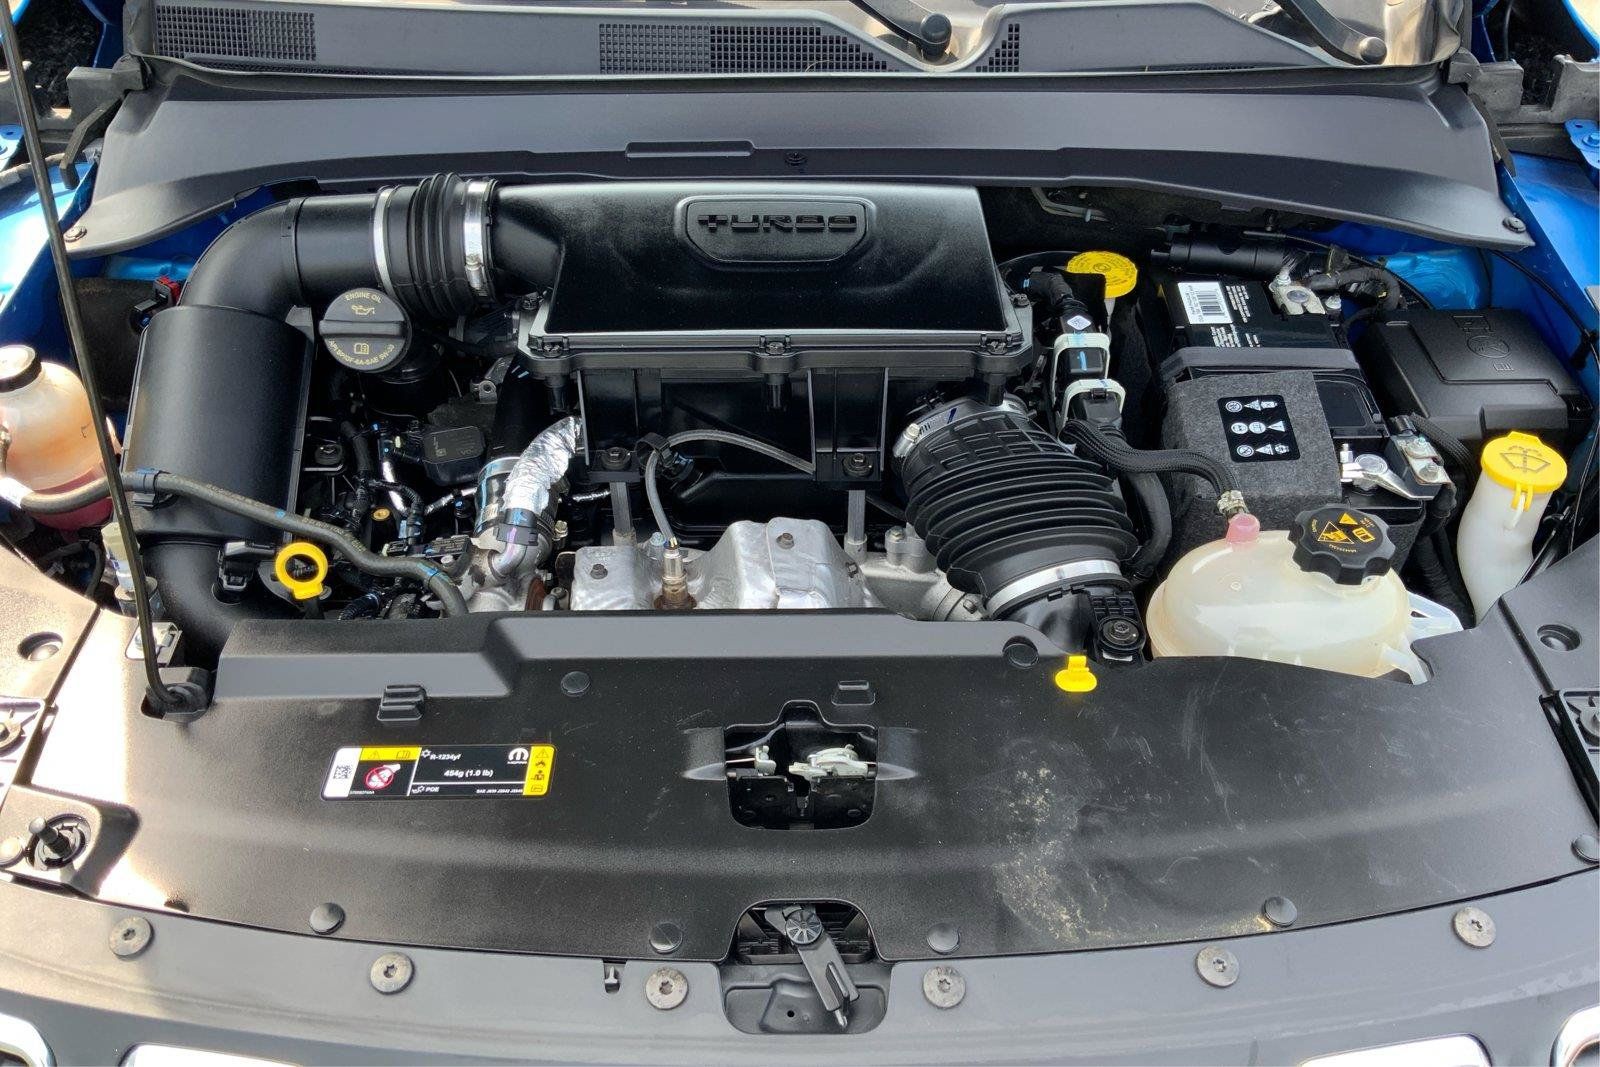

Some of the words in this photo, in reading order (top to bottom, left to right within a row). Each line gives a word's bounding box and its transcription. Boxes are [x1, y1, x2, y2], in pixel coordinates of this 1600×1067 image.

[698, 214, 858, 232] TURBO
[345, 290, 371, 301] ENGINE
[371, 293, 382, 304] OIL
[430, 753, 462, 761] R-1234yf
[444, 769, 465, 779] 454g
[465, 769, 481, 778] (1.0
[482, 769, 494, 778] lb)
